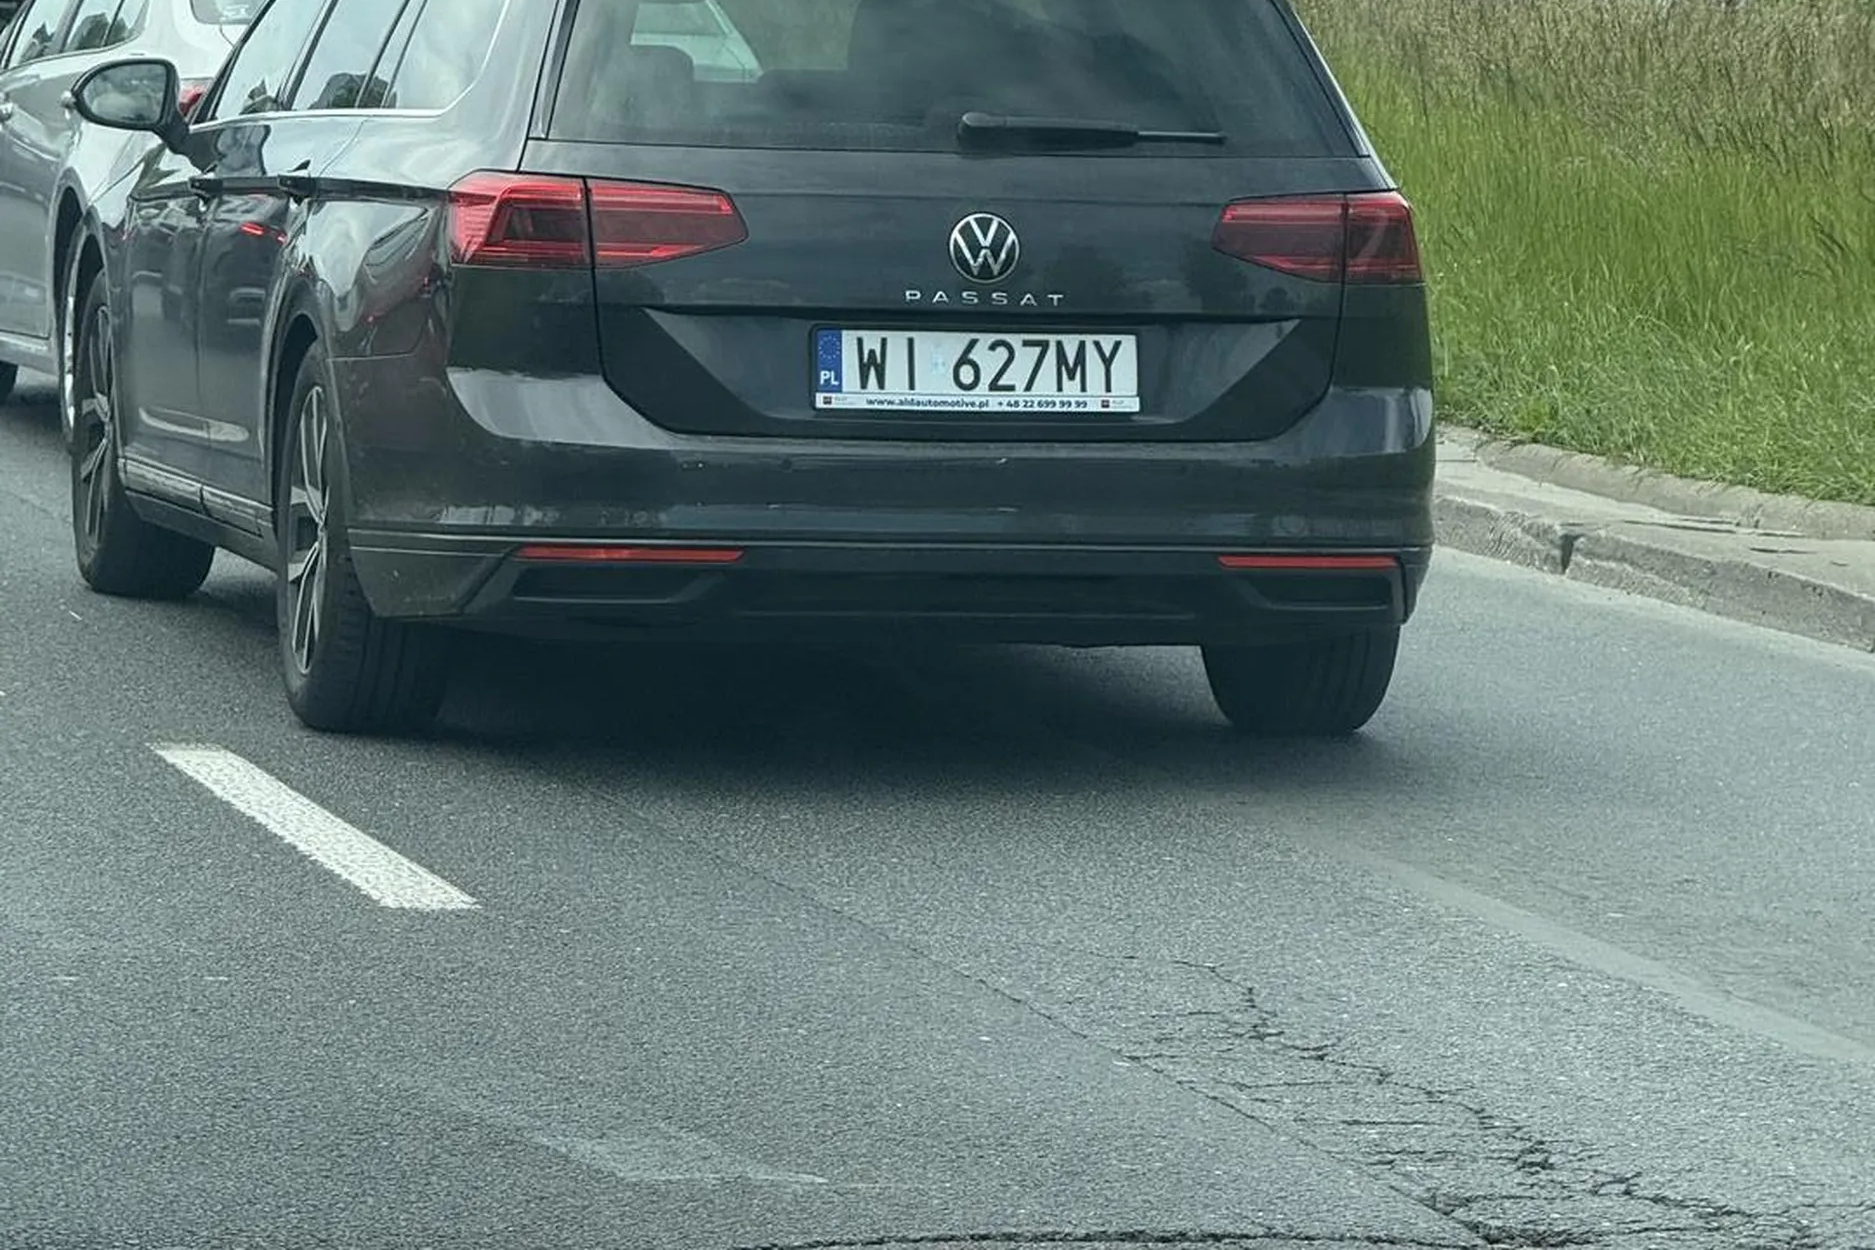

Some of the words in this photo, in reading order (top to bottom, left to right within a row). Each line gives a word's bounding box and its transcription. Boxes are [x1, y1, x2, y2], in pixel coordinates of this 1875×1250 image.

[904, 290, 1064, 307] PASSAT
[856, 336, 916, 391] WI
[952, 338, 1122, 393] 627MY
[820, 371, 839, 386] PL
[1022, 400, 1035, 408] 22
[1037, 400, 1056, 409] 699
[1059, 401, 1072, 409] 99
[1074, 401, 1088, 409] 99
